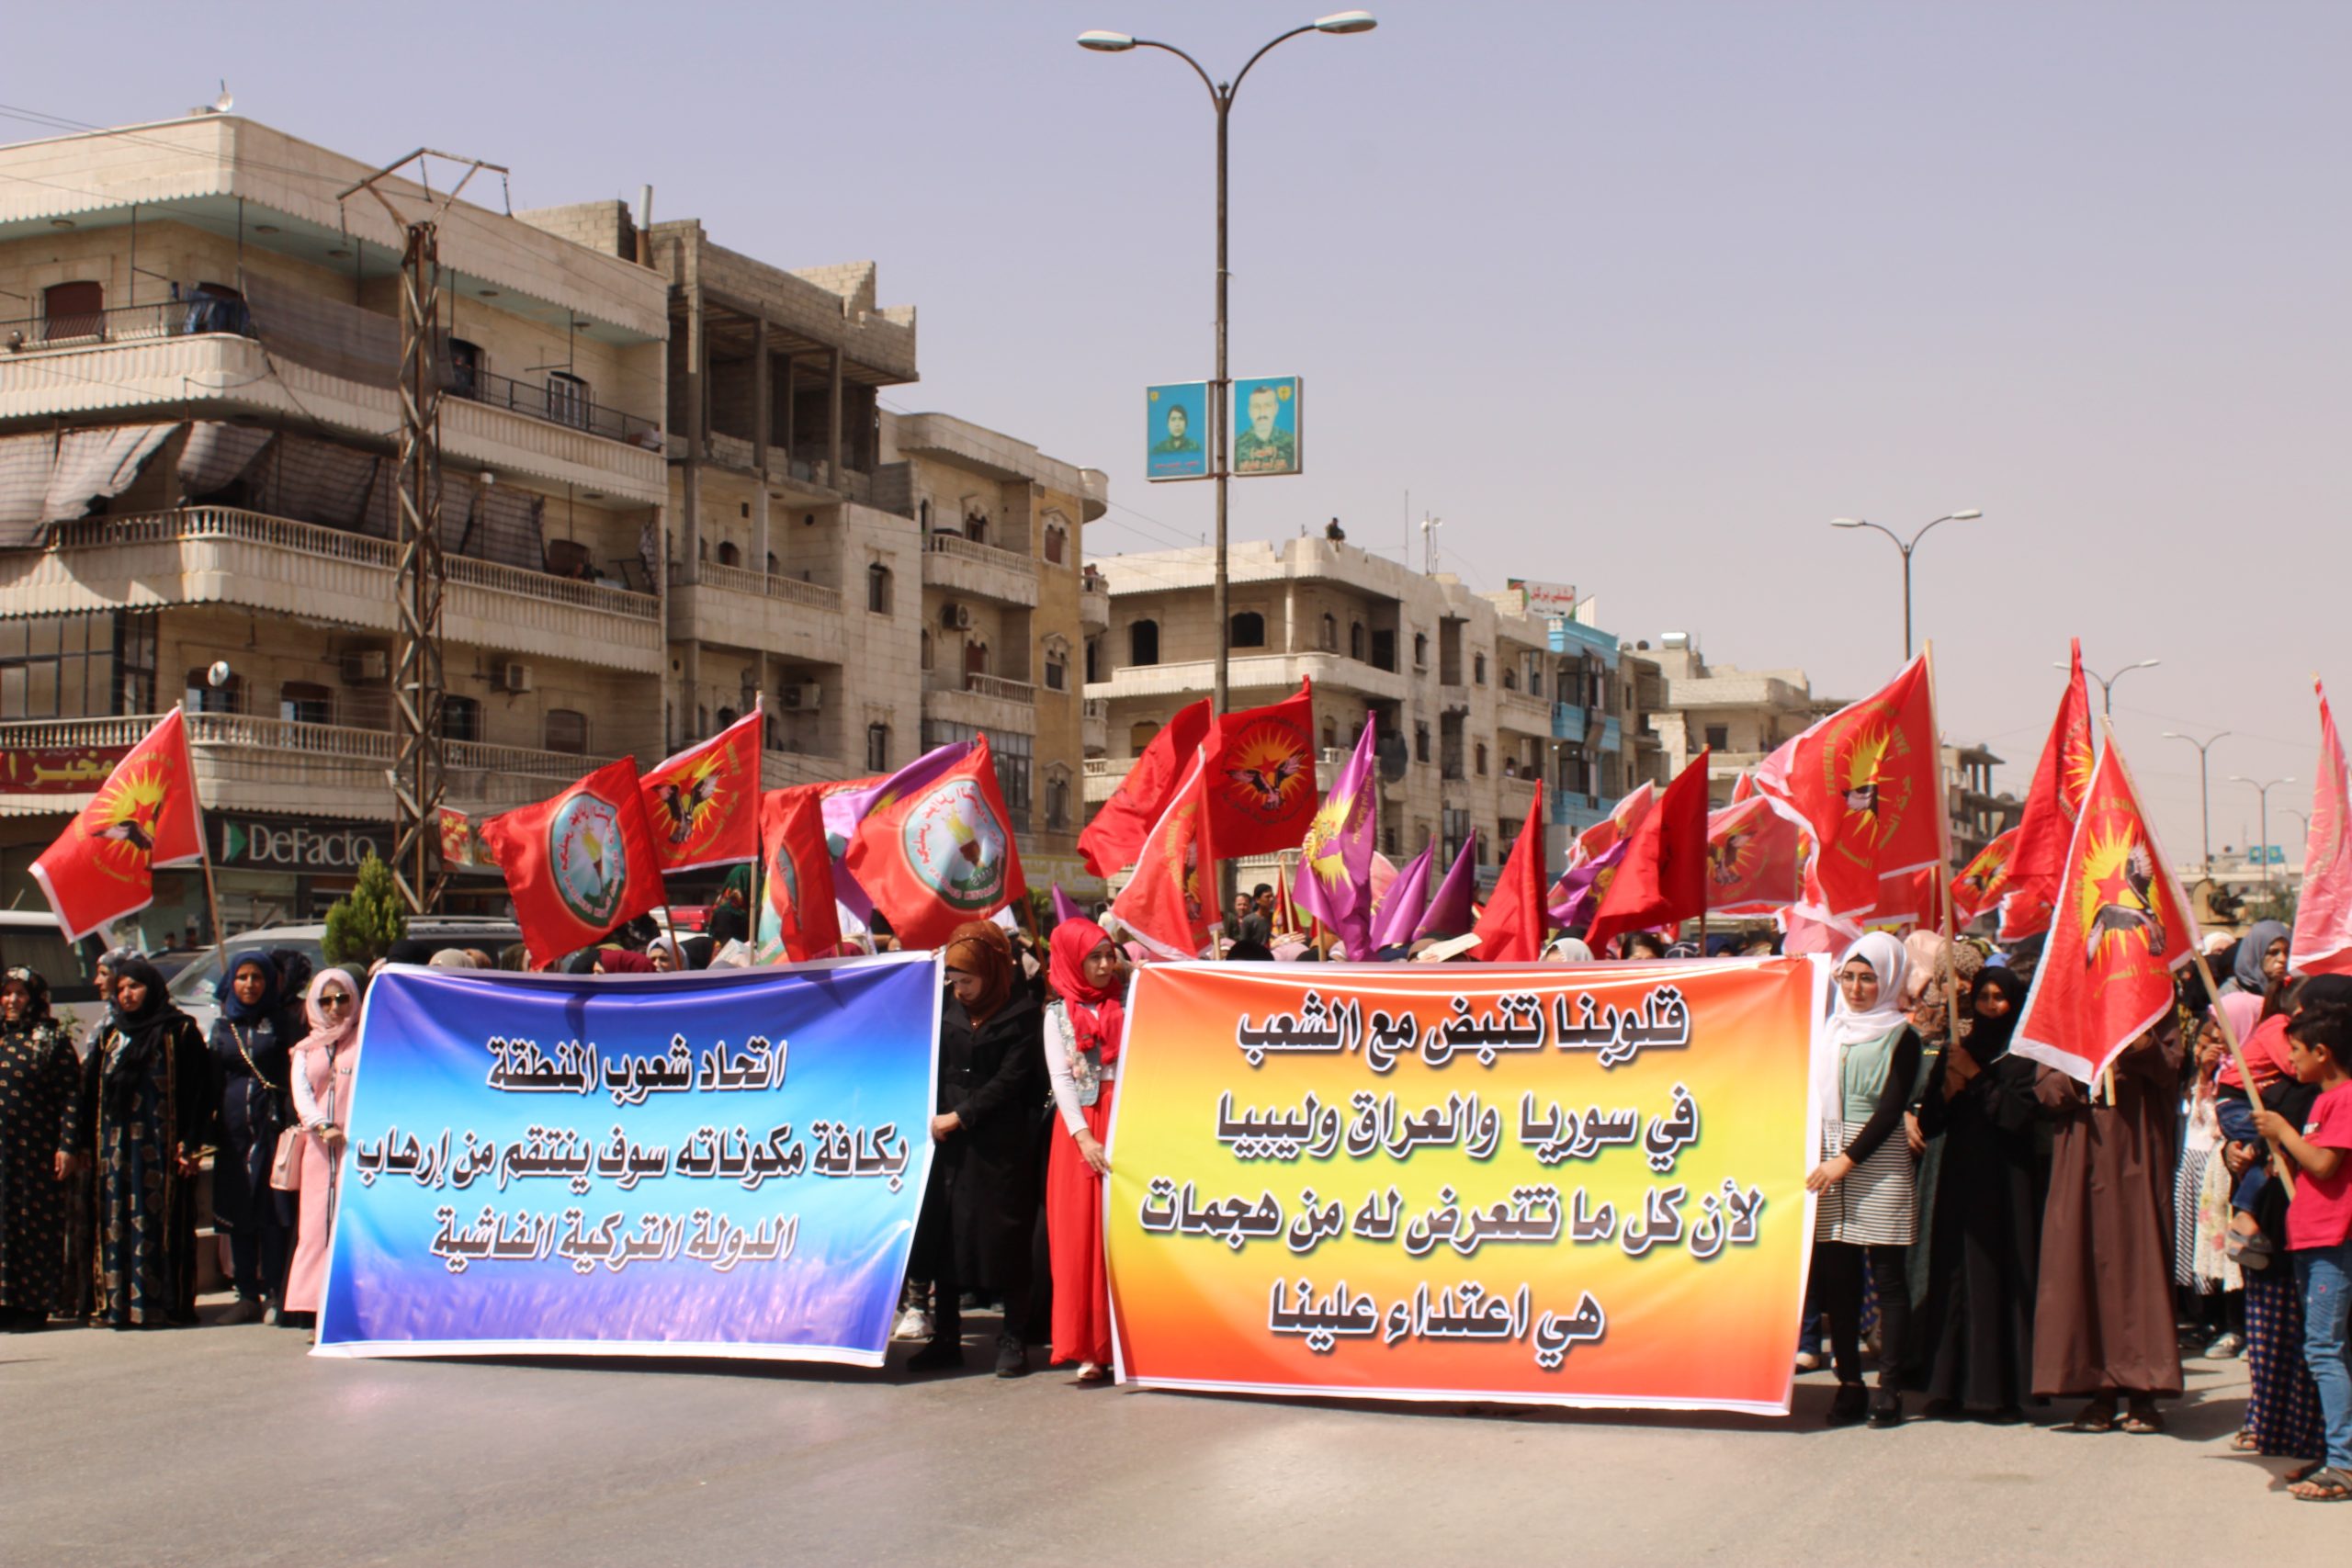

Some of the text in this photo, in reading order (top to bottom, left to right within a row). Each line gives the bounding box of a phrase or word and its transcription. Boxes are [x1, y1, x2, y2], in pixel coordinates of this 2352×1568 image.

[249, 824, 378, 866] DeFacto
[1237, 985, 1690, 1072] قلوبنا تنبض مع الشعب
[486, 1032, 788, 1106] اتحاد شعوب المنطقة
[354, 1120, 911, 1195] بكافة مكوناته سوف ينتقم من إرهاب
[1216, 1083, 1699, 1173] في سوريا والعراق وليبيا
[431, 1207, 798, 1274] الدولة التركية الفاشية
[1139, 1178, 1283, 1250] هجمات
[1287, 1188, 1344, 1253] من
[1353, 1184, 1402, 1240] له
[1570, 1189, 1617, 1244] ما
[1622, 1183, 1685, 1255] كل
[1689, 1178, 1764, 1259] لأن
[1270, 1278, 1607, 1370] هي اعتداء علينا
